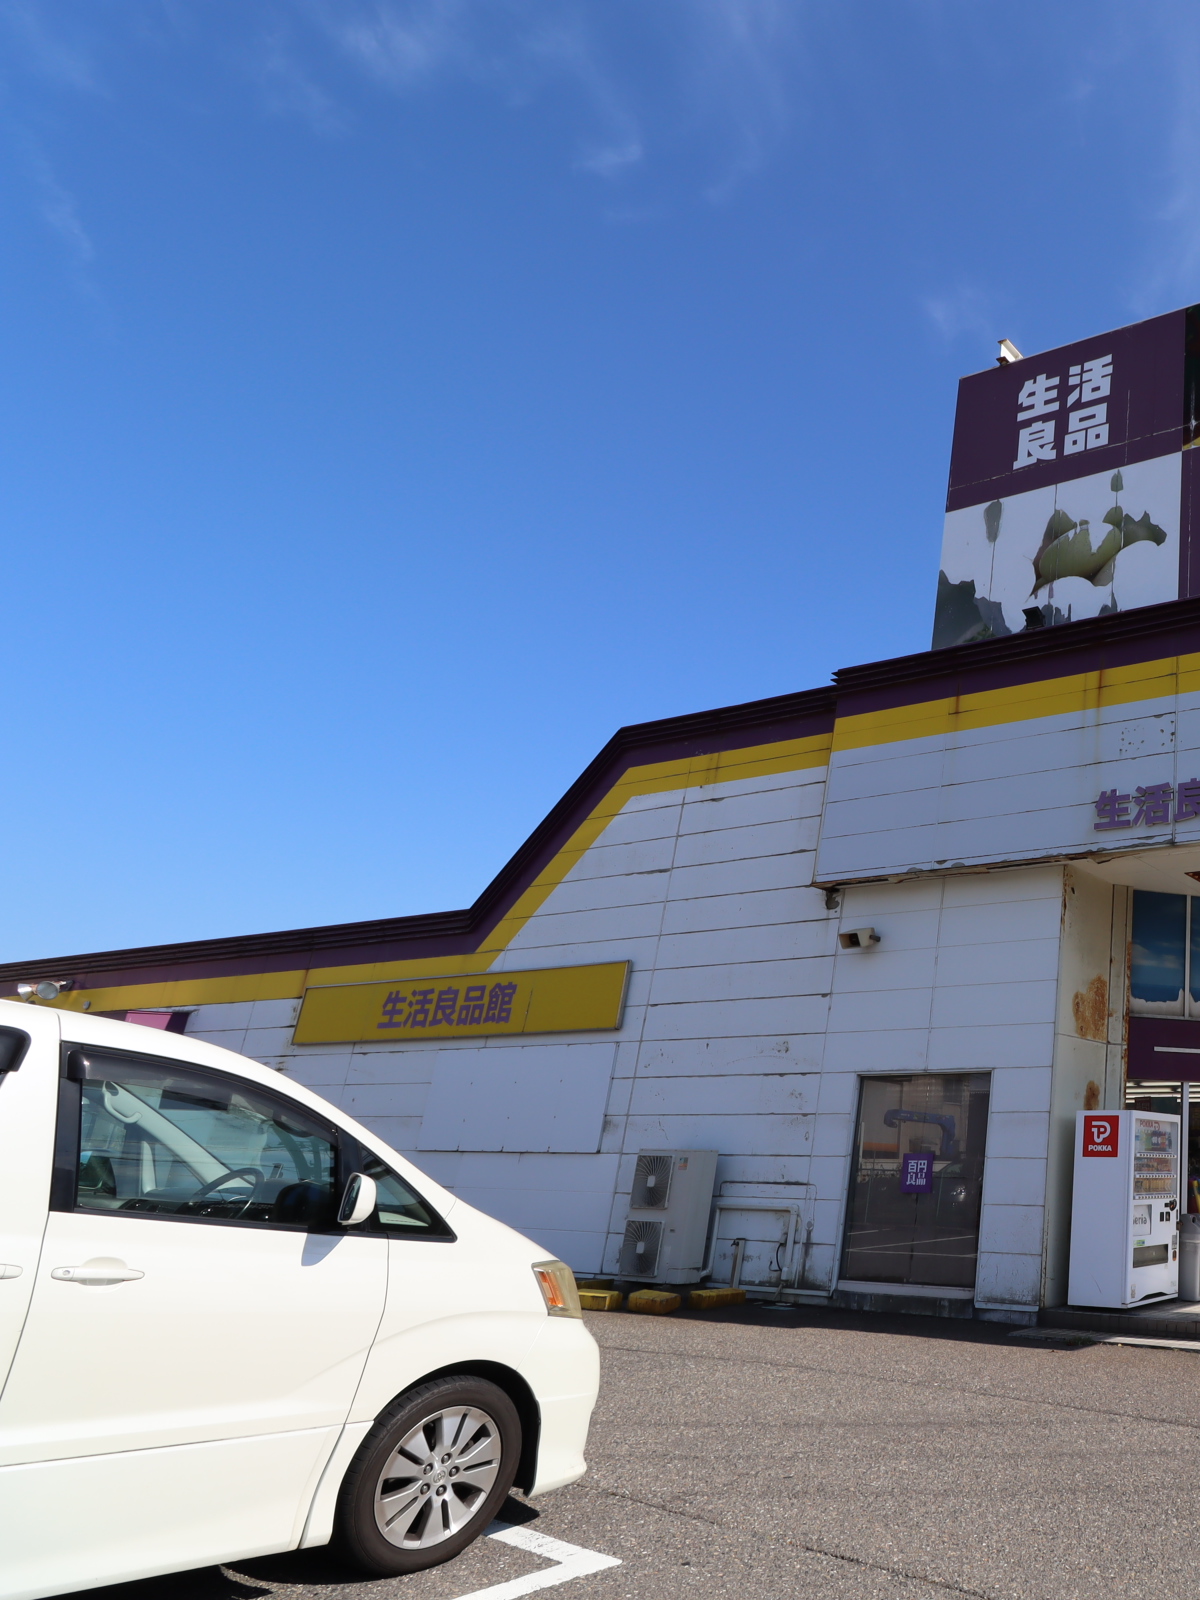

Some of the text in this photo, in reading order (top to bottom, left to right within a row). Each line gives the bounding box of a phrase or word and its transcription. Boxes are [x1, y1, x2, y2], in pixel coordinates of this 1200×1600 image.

[1015, 353, 1114, 422] 生活
[1011, 402, 1111, 471] 良品
[376, 980, 518, 1031] 生活良品館
[1088, 1144, 1112, 1152] POKKA
[906, 1172, 926, 1186] 良品
[908, 1160, 928, 1173] 百円
